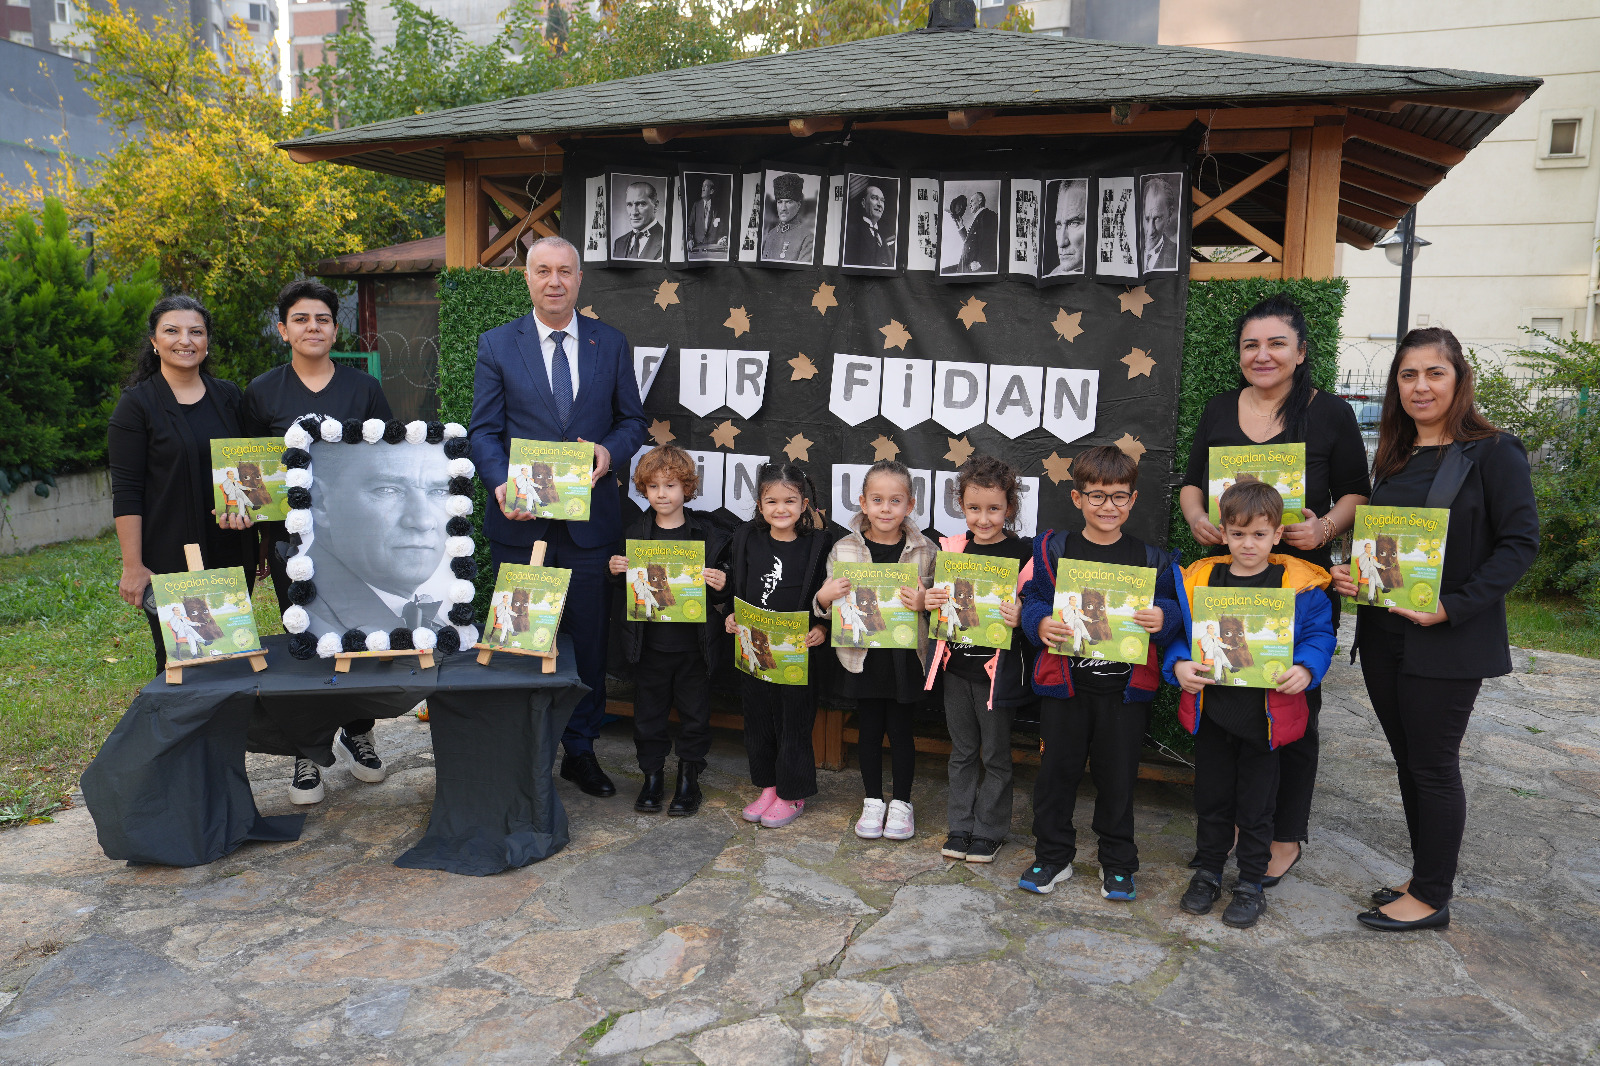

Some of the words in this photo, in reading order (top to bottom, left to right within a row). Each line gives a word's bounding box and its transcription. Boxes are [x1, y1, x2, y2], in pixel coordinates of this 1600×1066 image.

[267, 442, 288, 453] Sev
[562, 447, 586, 459] Sevgi
[1267, 451, 1298, 466] Sevgi
[1409, 513, 1439, 532] Sevgi
[672, 545, 698, 560] Sevgi
[884, 569, 910, 582] Sevgi
[984, 563, 1012, 578] Sevgi
[210, 575, 238, 588] Sevgi
[540, 571, 563, 586] Sevgi
[1117, 570, 1147, 588] Sevgi
[1254, 593, 1285, 610] Sevgi
[776, 616, 802, 629] Sevgi
